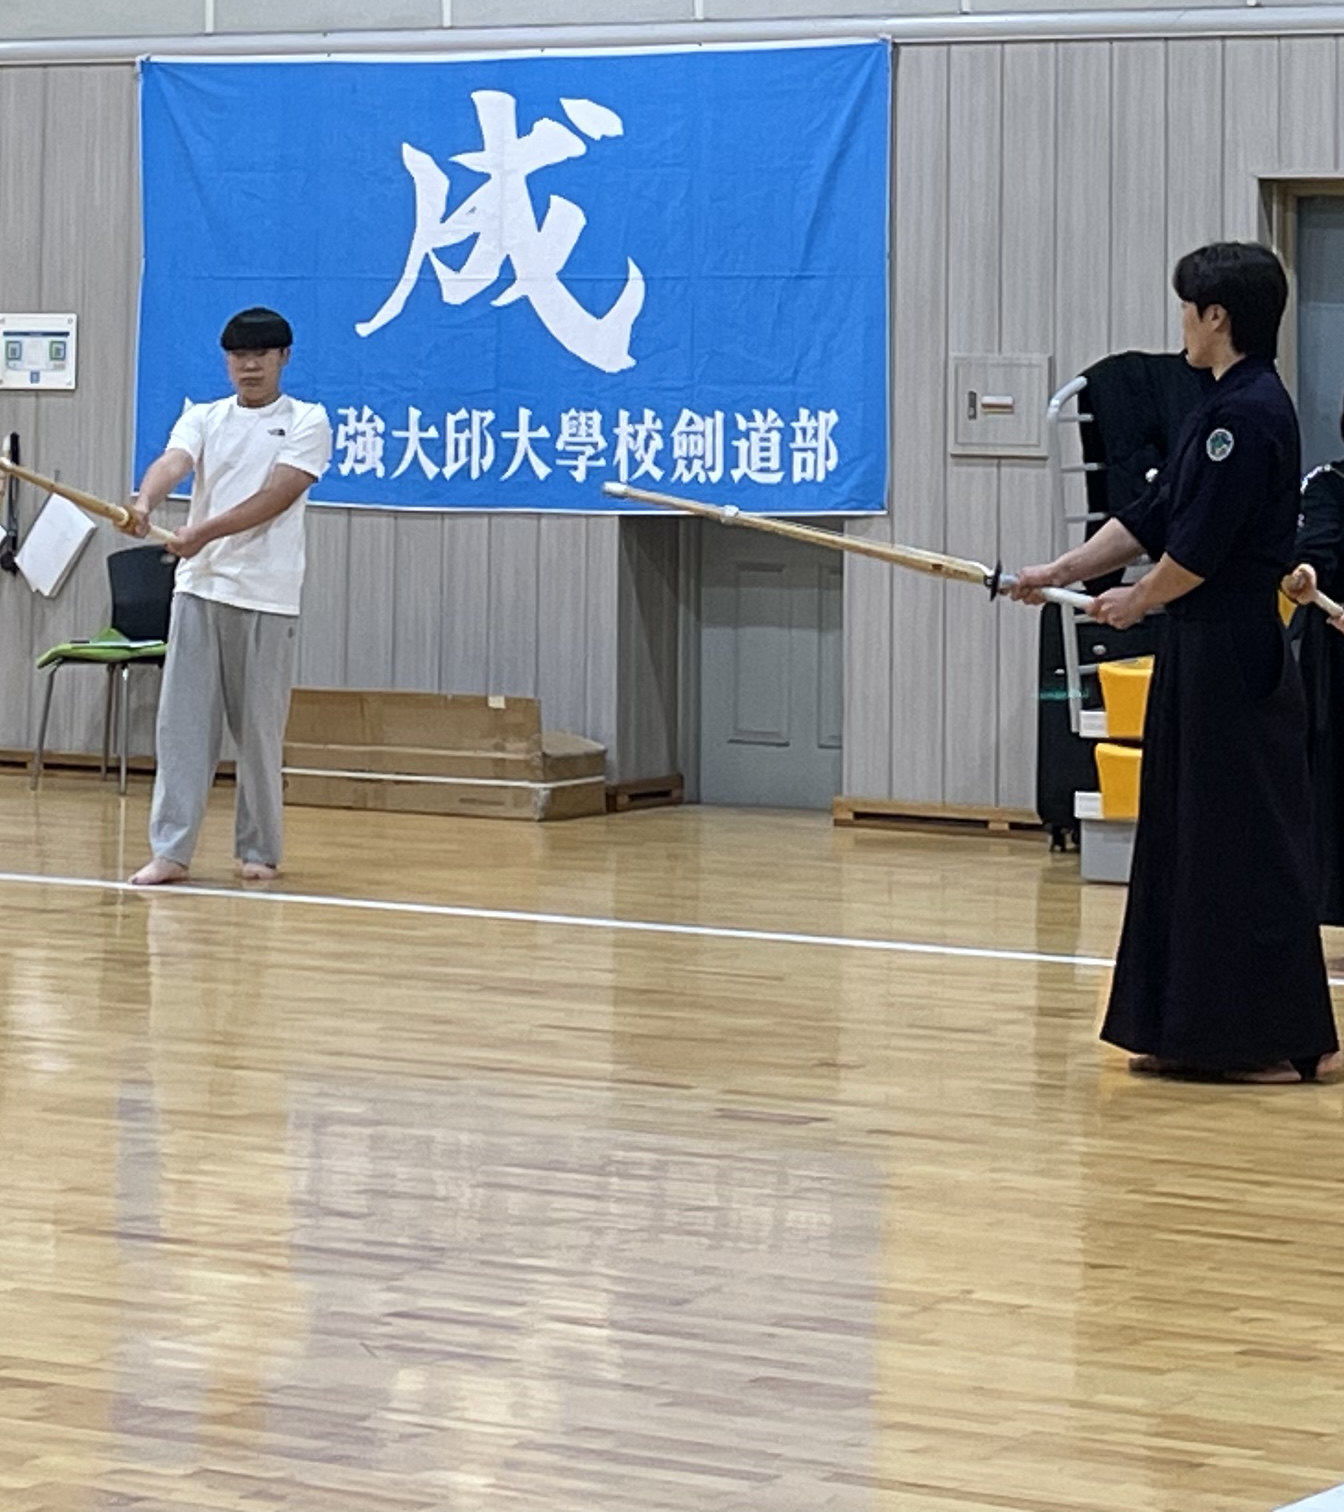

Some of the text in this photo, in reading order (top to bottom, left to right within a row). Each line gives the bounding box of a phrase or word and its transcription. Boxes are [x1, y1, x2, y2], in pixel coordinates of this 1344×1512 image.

[354, 89, 646, 374] 成
[319, 404, 840, 485] 強大邱大學校劍道部
